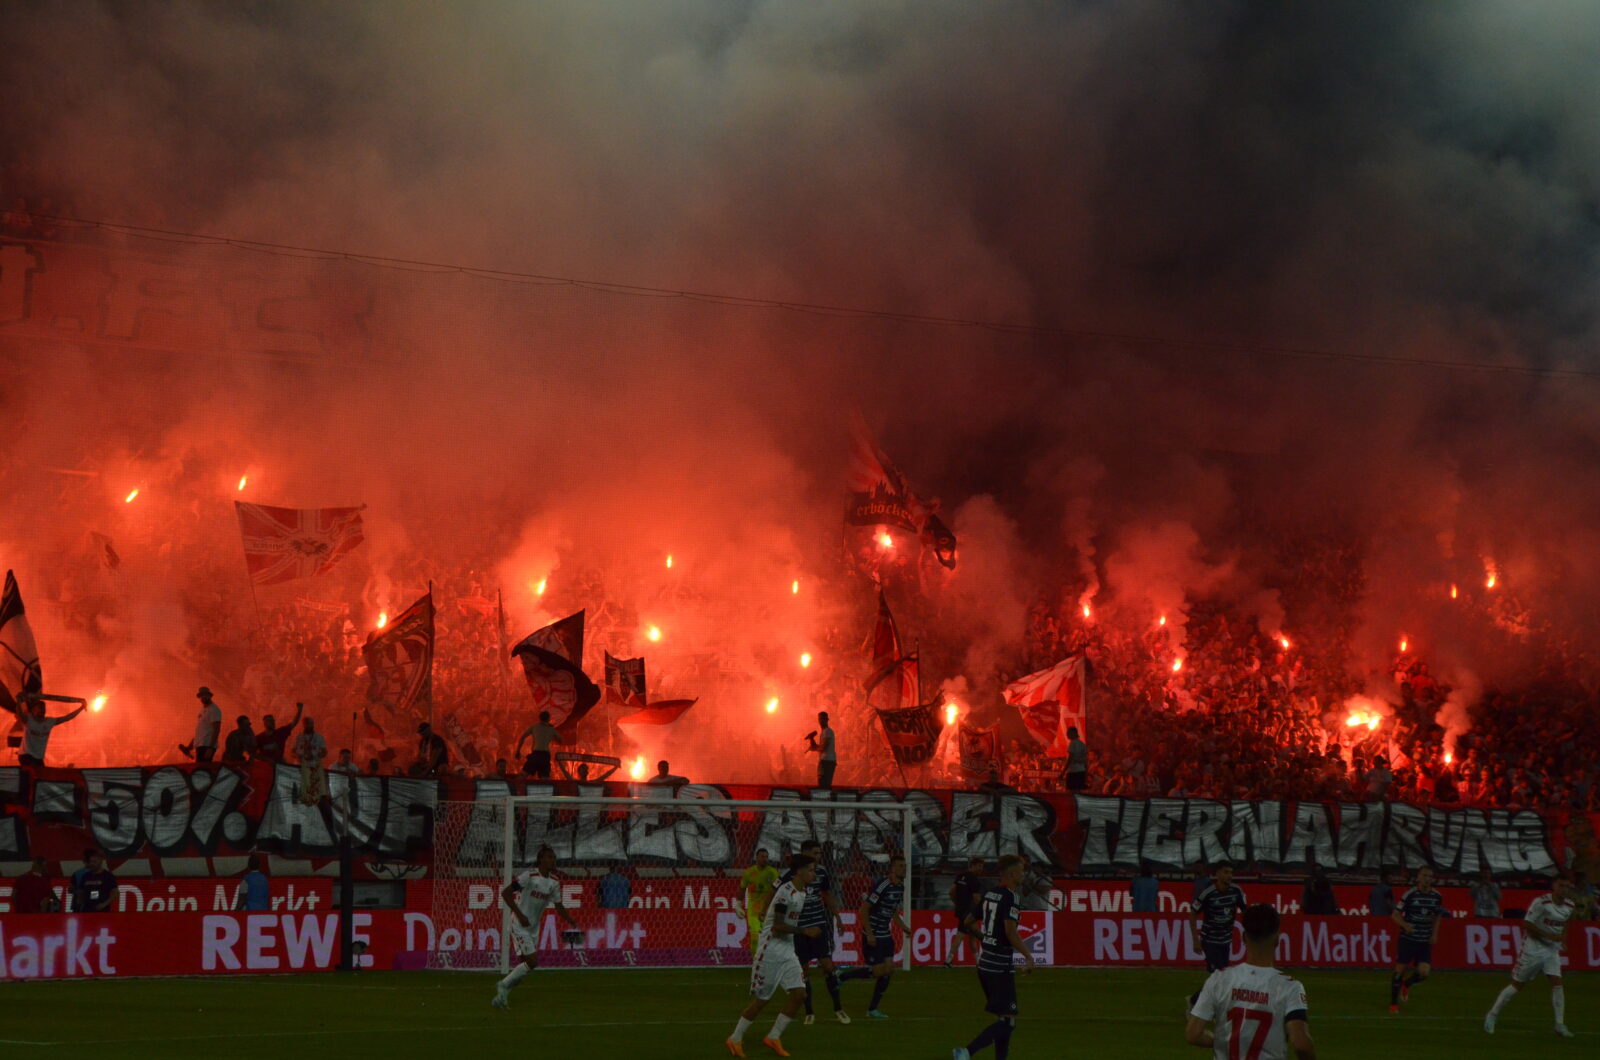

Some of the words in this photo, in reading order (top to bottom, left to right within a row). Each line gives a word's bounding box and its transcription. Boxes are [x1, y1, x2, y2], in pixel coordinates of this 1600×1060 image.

[256, 762, 437, 858] AUF
[457, 779, 736, 866] ALLES
[754, 787, 1056, 870] AUSSER
[1073, 794, 1560, 877] TIERNAHRUNG
[202, 912, 374, 970] REWE
[1301, 921, 1392, 964] Markt
[1226, 1006, 1274, 1060] 17
